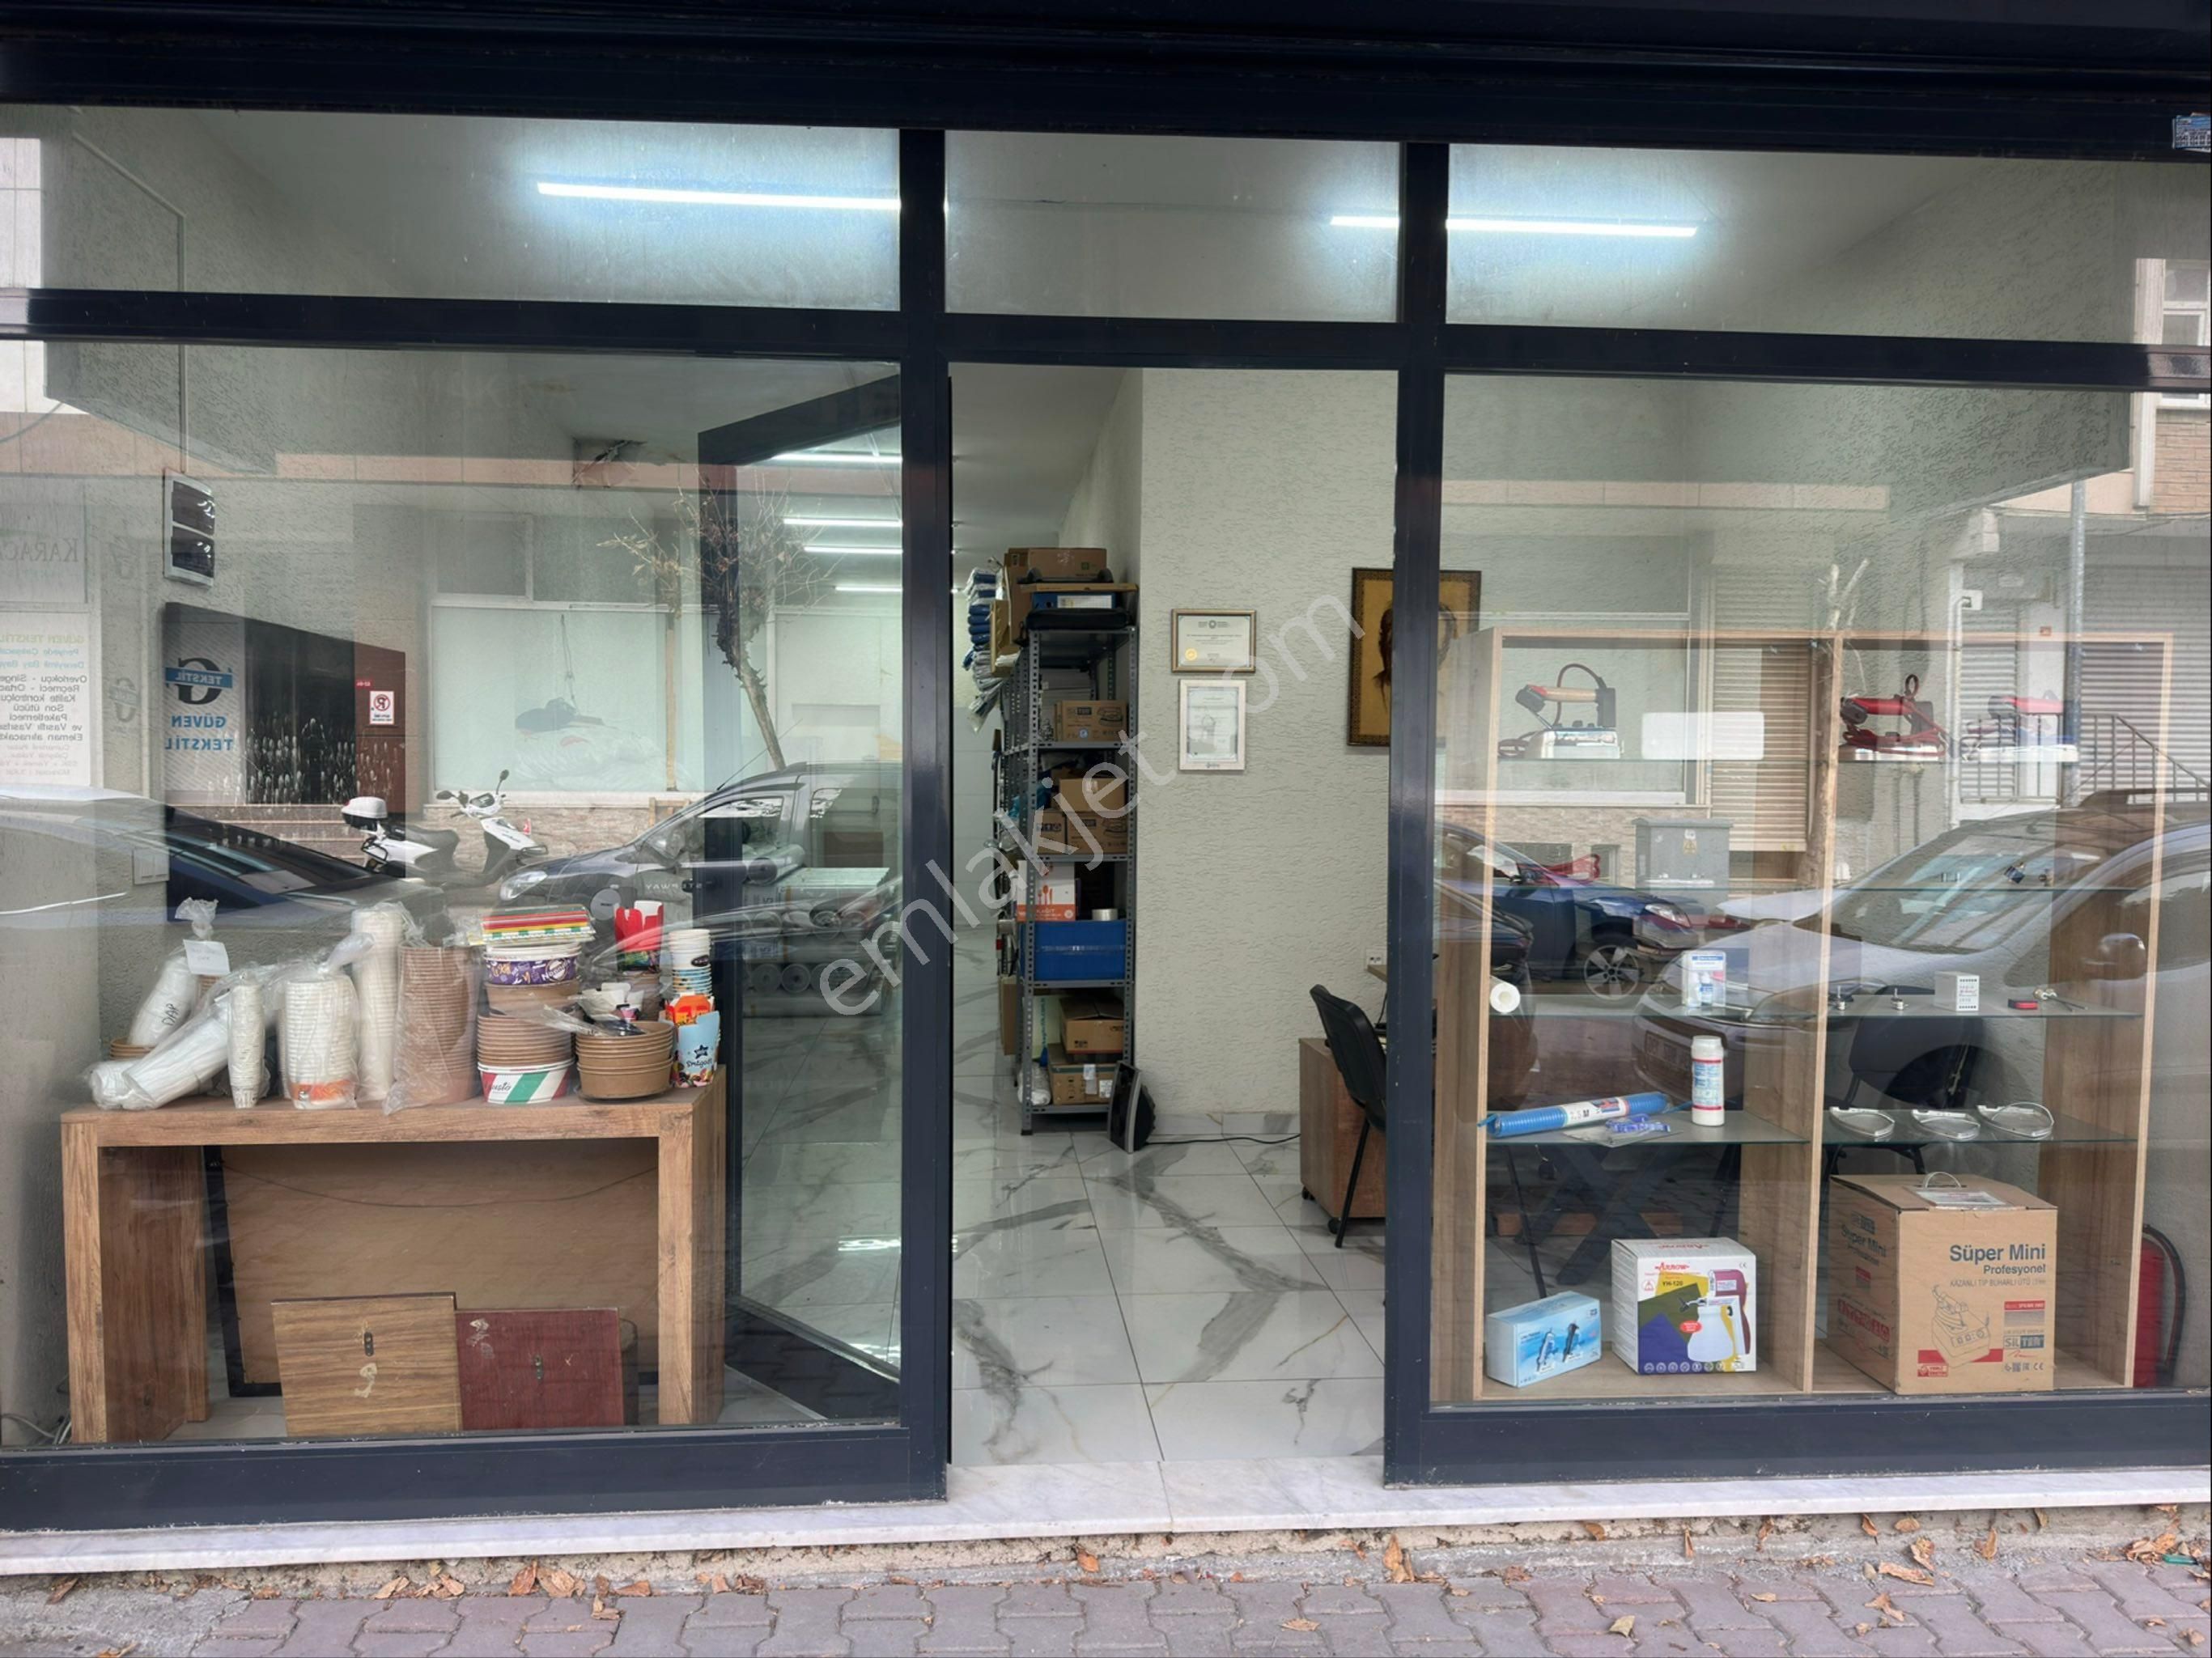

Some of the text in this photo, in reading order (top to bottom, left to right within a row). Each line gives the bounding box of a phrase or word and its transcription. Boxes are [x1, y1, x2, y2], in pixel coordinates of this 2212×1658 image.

[1949, 1244, 2046, 1265] Süper Mini
[1983, 1264, 2046, 1277] Profesyonel
